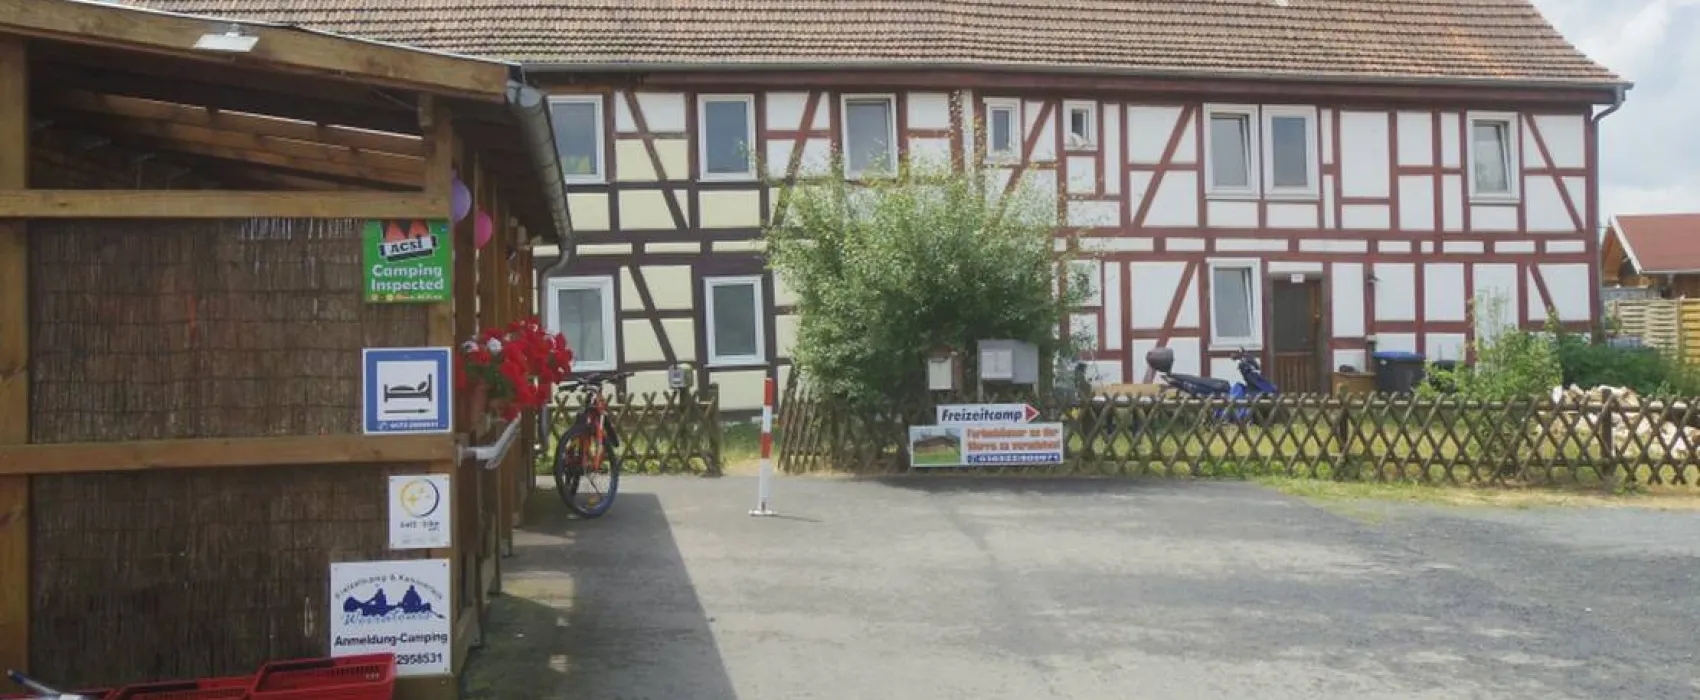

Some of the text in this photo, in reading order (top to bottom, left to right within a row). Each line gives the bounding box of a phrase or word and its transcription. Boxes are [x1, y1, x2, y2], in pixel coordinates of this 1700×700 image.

[372, 264, 442, 278] Camping
[371, 278, 444, 293] Inspected
[941, 408, 1022, 422] Freizeitcamp
[334, 633, 448, 647] Anmeldung-Camping
